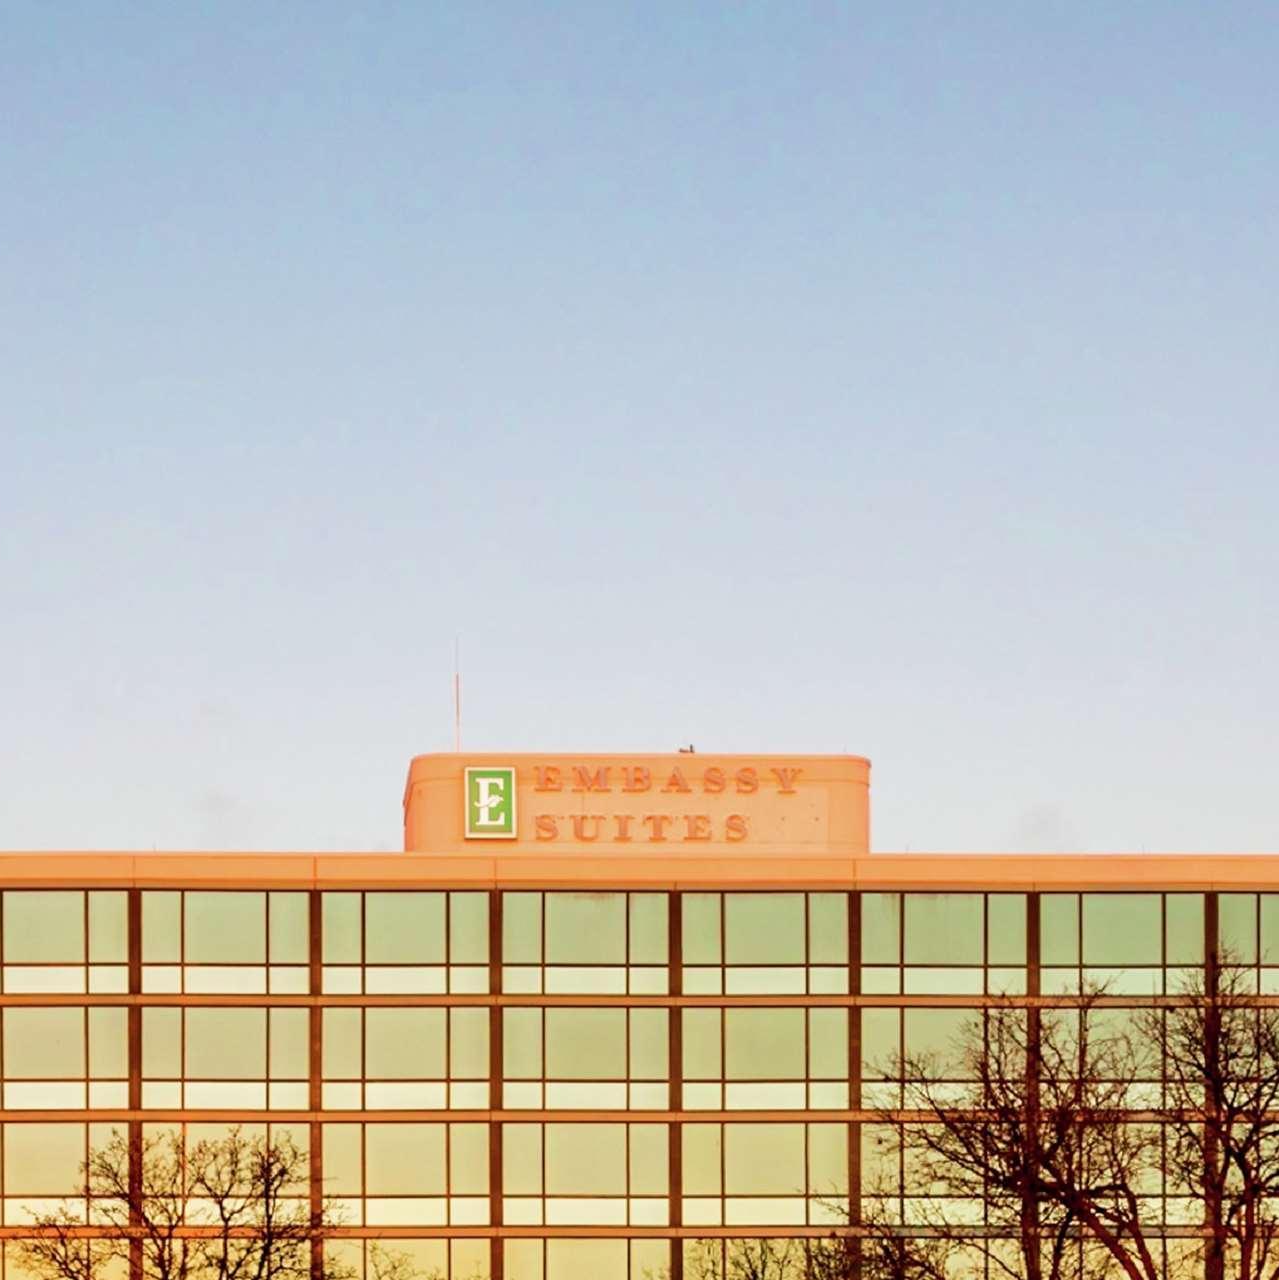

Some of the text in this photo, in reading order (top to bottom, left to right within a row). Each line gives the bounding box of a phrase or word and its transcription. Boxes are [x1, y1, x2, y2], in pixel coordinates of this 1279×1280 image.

[533, 766, 804, 794] EMBASSY
[474, 777, 506, 827] E
[534, 815, 750, 842] SUITES
